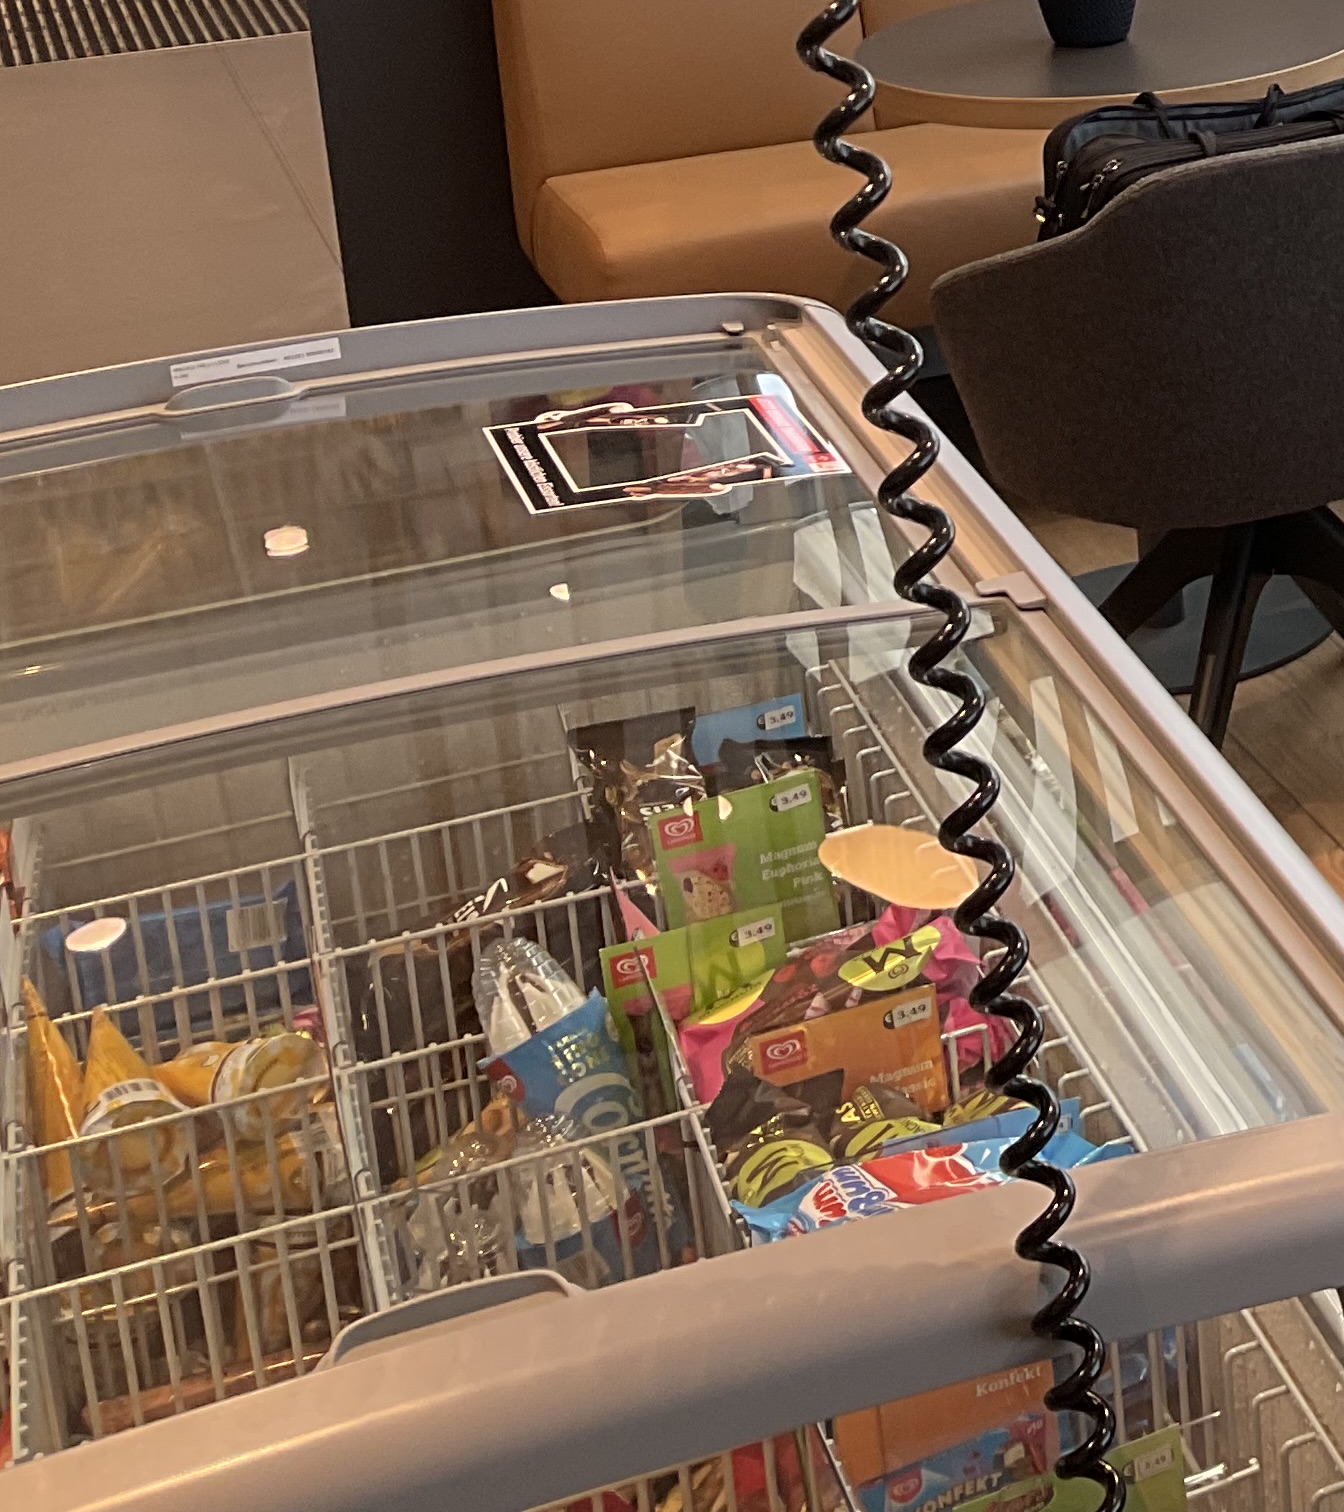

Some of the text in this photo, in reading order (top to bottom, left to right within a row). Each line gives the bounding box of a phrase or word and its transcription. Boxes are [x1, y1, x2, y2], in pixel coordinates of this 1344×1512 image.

[769, 710, 794, 725] 3.49
[780, 789, 807, 805] 3.49
[760, 840, 818, 865] Magnum
[793, 871, 824, 888] Pink
[744, 923, 773, 939] 3.49
[896, 1003, 927, 1020] 3.49
[975, 1366, 1042, 1397] Konfekt
